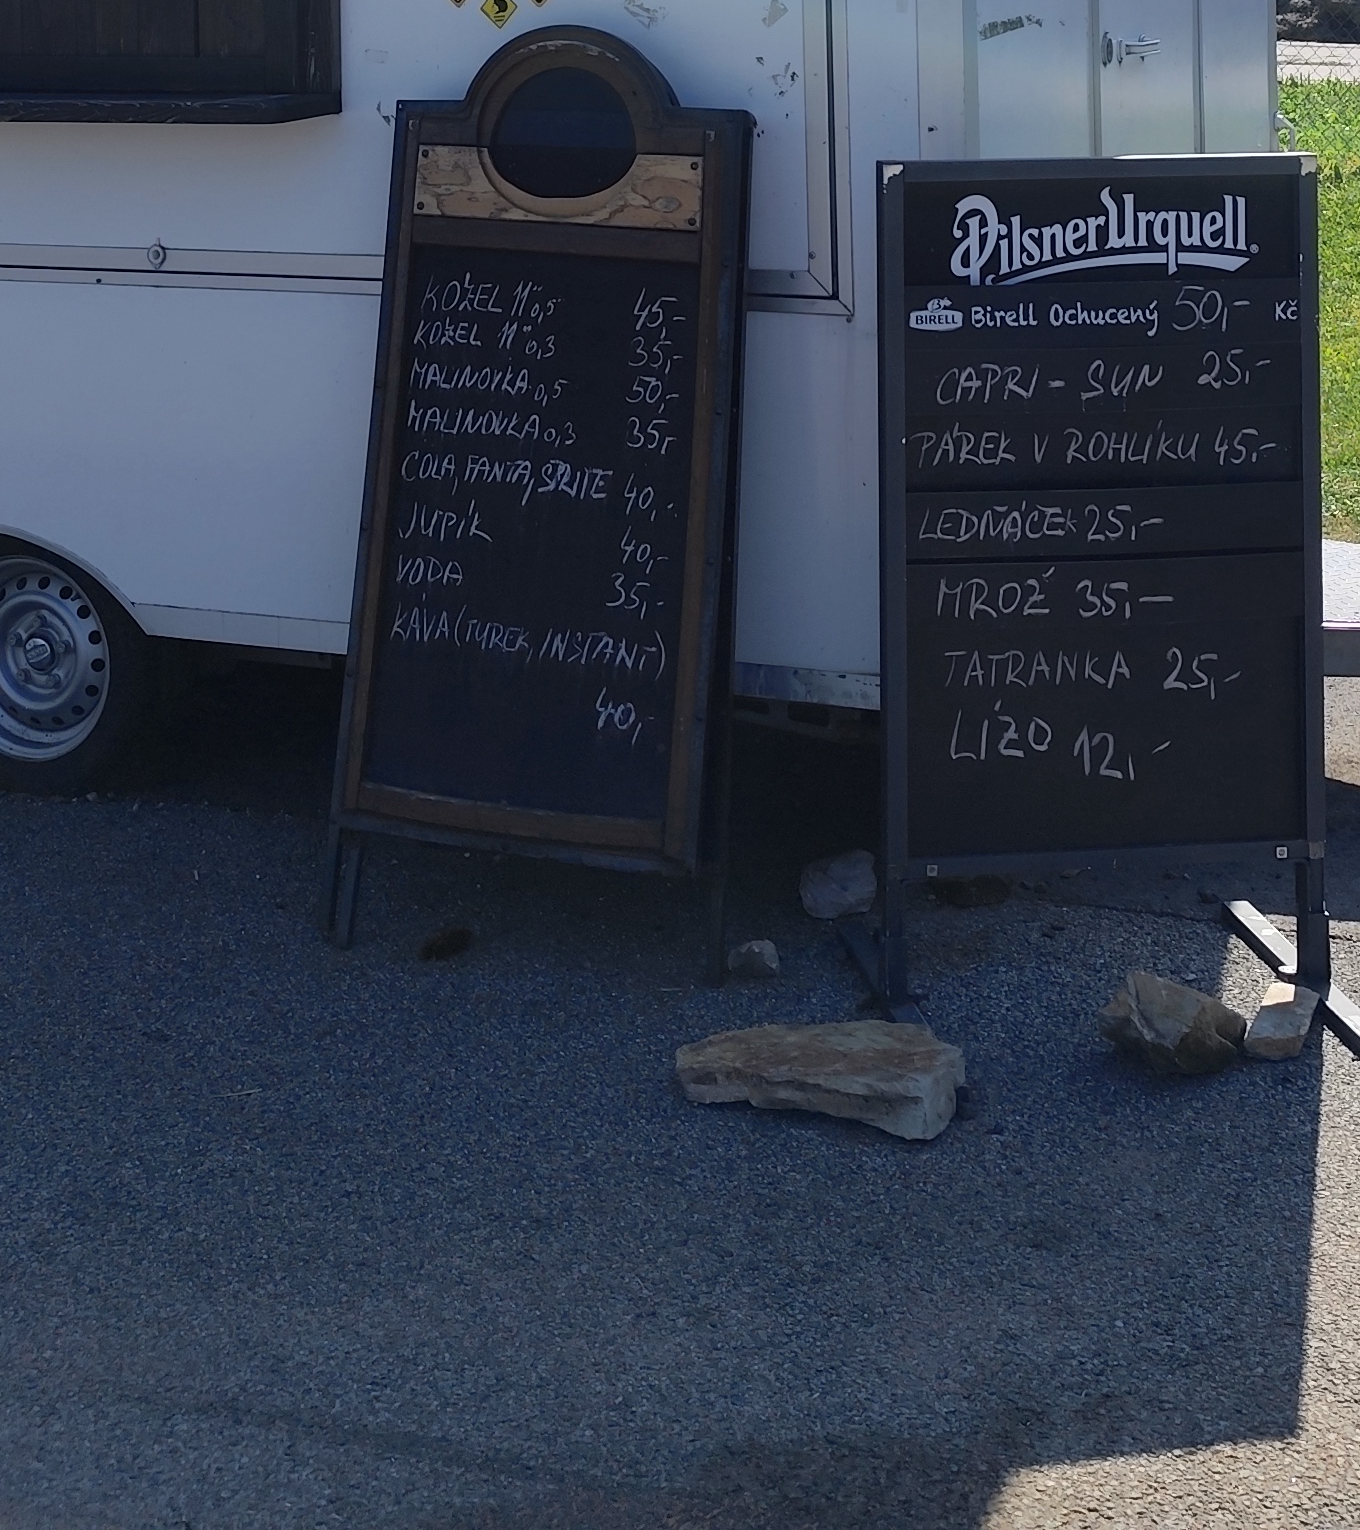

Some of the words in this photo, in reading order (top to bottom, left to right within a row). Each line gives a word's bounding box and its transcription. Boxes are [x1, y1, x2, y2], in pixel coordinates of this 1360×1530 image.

[950, 194, 1106, 286] Pilsner
[1100, 185, 1249, 276] Urquell
[915, 314, 959, 325] BIRELL
[971, 302, 1038, 328] Birell
[1049, 300, 1160, 337] Ochucený
[1274, 299, 1298, 322] Kč
[409, 357, 529, 396] MALINOVKA
[936, 362, 1039, 405] CAPRI
[1080, 359, 1164, 402] SUN
[407, 399, 540, 440] MALINOVKA
[909, 421, 1017, 468] PÁREK
[1032, 432, 1049, 463] V
[1063, 419, 1201, 465] ROHLÍKU
[398, 499, 493, 543] JUPÍK
[396, 554, 464, 586] VODA
[944, 650, 1132, 689] TATRANKA
